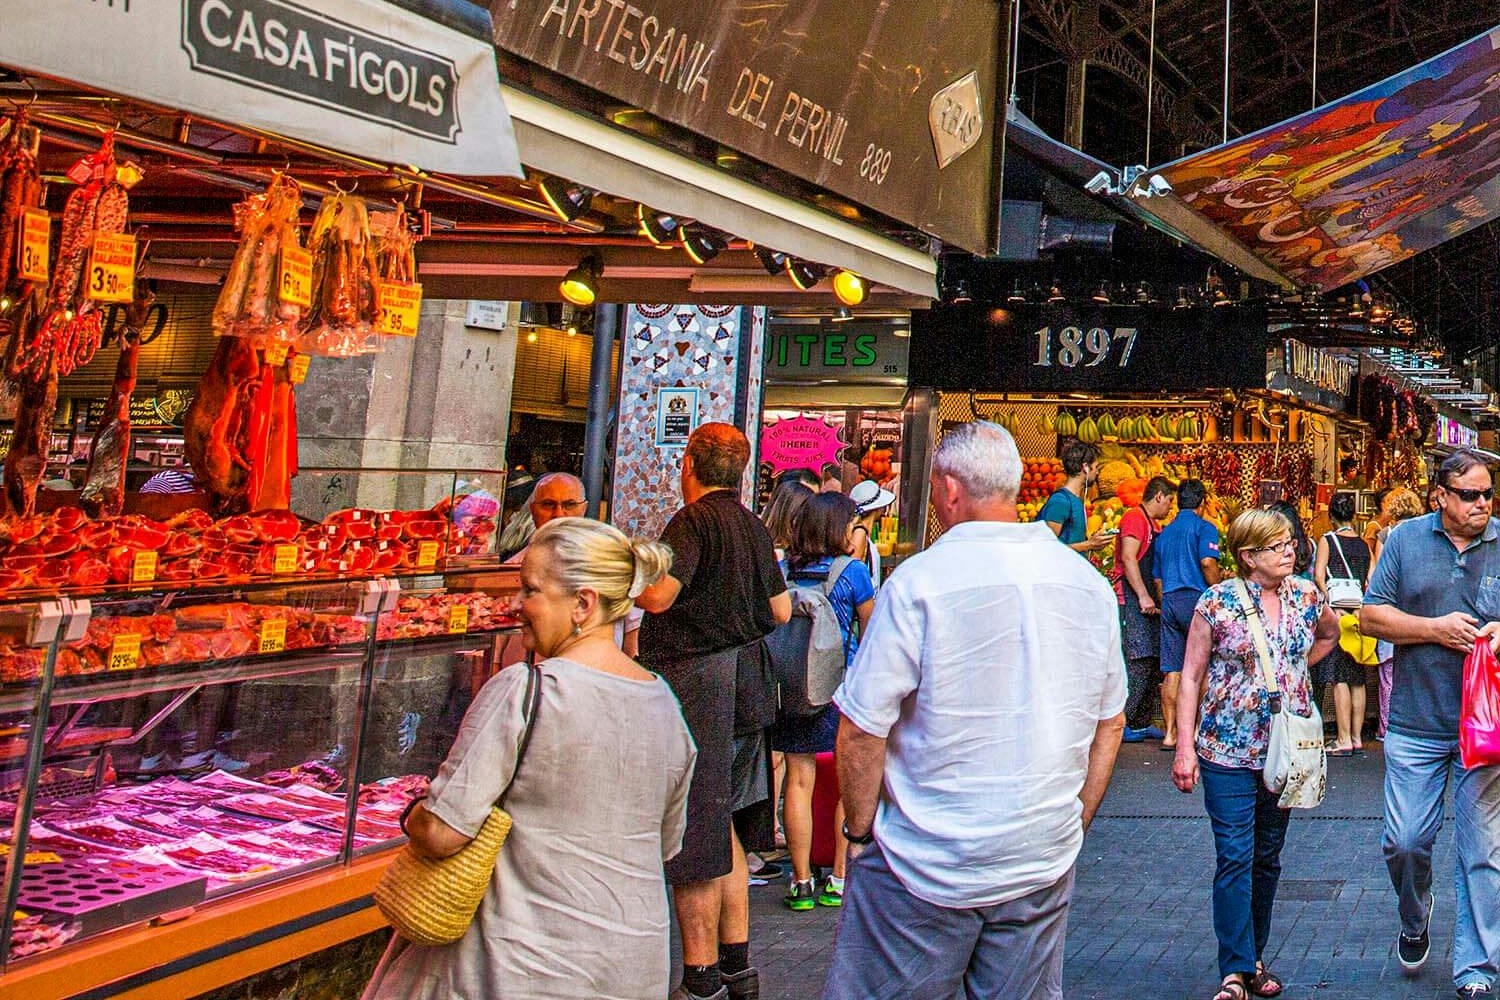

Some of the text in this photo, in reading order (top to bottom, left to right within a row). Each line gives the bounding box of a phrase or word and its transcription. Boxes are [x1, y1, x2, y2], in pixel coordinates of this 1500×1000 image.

[324, 36, 446, 117] FÍGOLS
[726, 67, 775, 130] DEL
[775, 91, 848, 165] PERNIL
[860, 143, 892, 185] 889
[1033, 326, 1138, 367] 1897
[883, 365, 897, 373] 515
[792, 425, 830, 441] NATURAL
